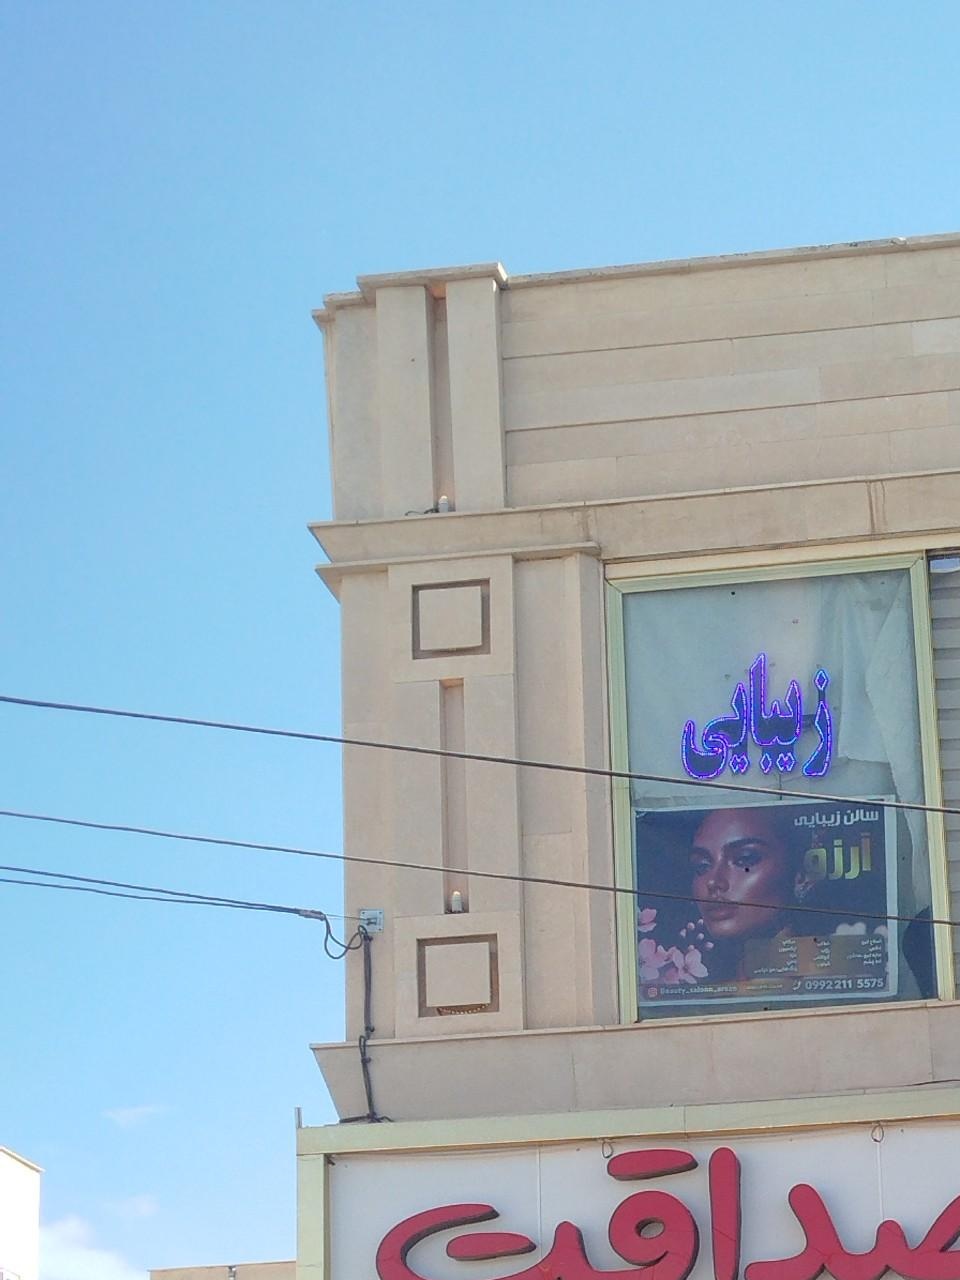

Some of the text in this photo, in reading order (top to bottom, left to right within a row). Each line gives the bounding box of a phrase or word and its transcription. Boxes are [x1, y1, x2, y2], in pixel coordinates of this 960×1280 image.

[681, 652, 833, 780] زیبایی
[794, 809, 879, 828] سالن زیبایی
[804, 832, 872, 880] آرزو
